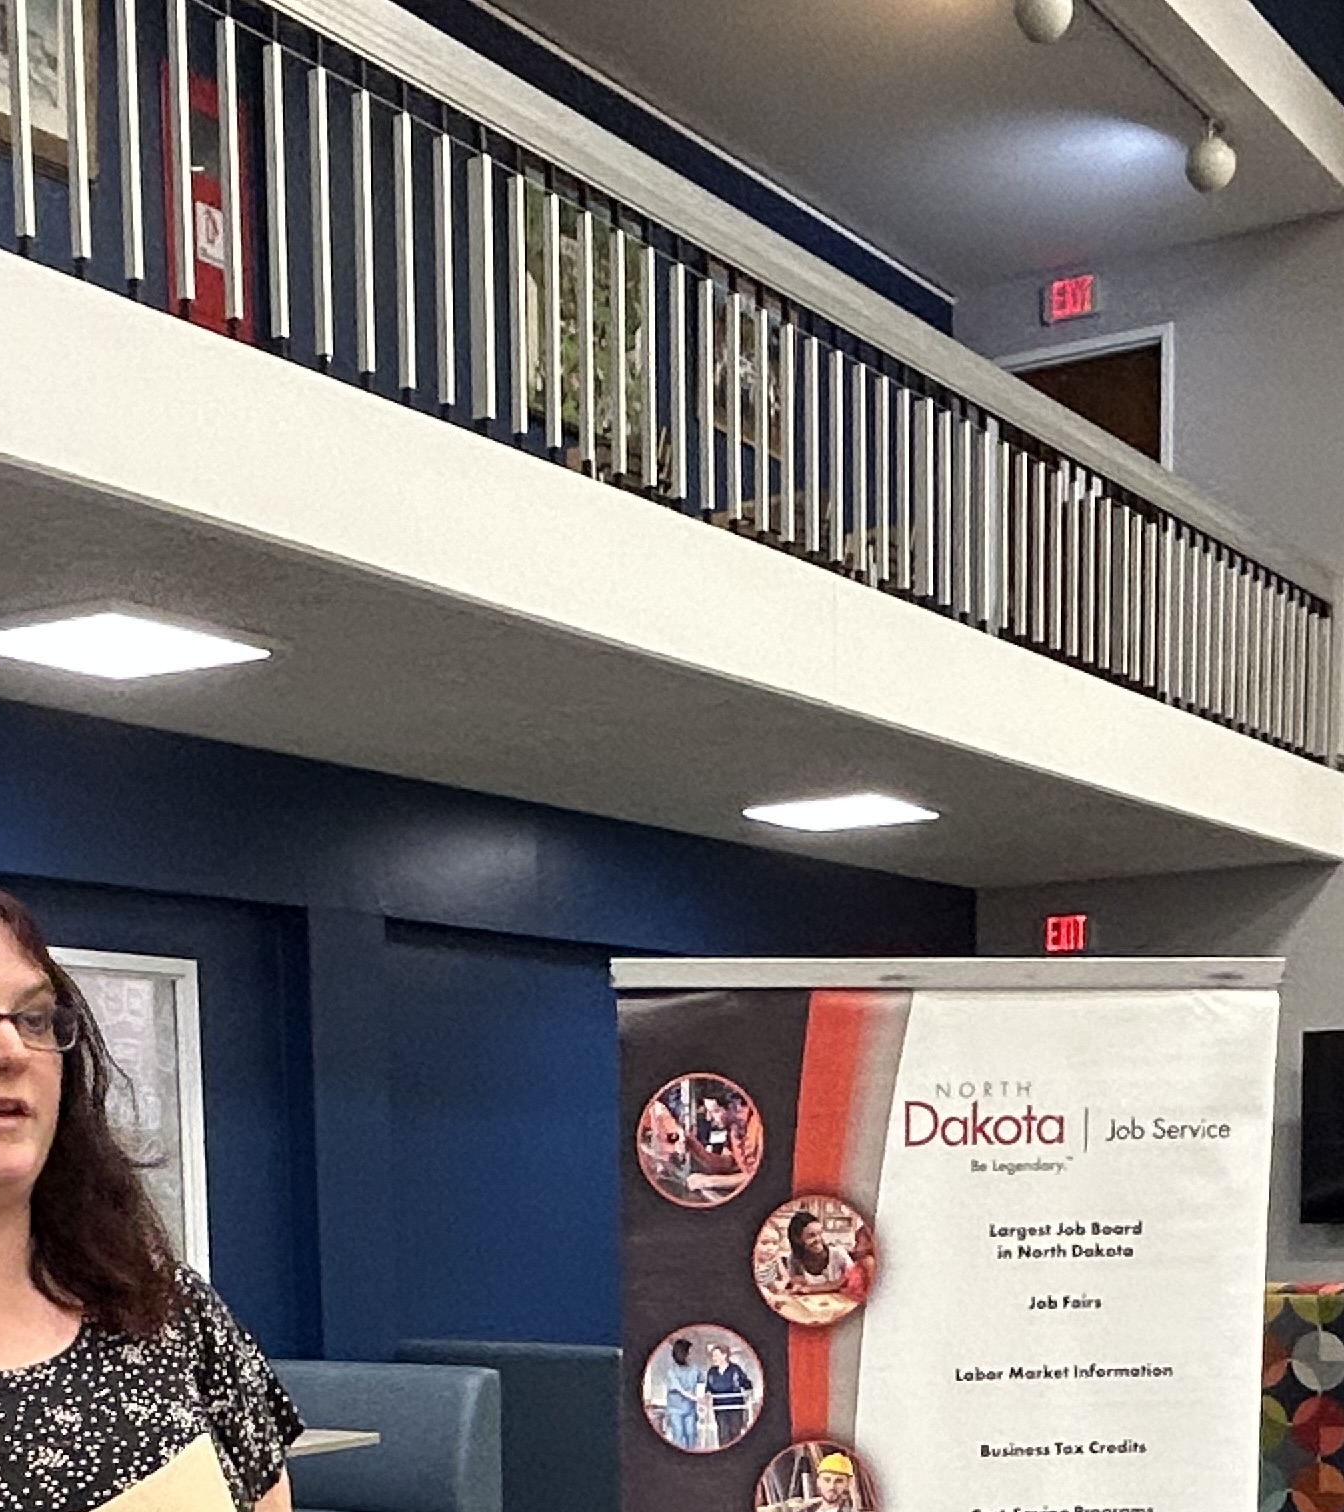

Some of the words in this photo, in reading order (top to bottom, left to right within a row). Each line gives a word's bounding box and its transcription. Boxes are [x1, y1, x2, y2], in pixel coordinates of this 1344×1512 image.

[1051, 275, 1093, 318] EXIT
[1046, 915, 1087, 951] EXIT
[935, 1080, 1033, 1100] NORTH
[904, 1100, 1065, 1148] Dakota
[1104, 1116, 1146, 1142] Job
[1152, 1117, 1232, 1140] Service
[988, 1224, 1052, 1242] Largest
[1056, 1221, 1086, 1236] Job
[1090, 1220, 1143, 1236] Board
[996, 1244, 1013, 1260] in
[1017, 1243, 1067, 1260] North
[1071, 1242, 1134, 1258] Dakota
[1028, 1294, 1058, 1310] Job
[1062, 1294, 1102, 1310] Fairs
[955, 1366, 1004, 1382] Labor
[1008, 1365, 1070, 1380] Market
[1073, 1363, 1174, 1379] Information
[980, 1442, 1051, 1458] Business
[1054, 1442, 1084, 1456] Tax
[1088, 1439, 1148, 1454] Credits
